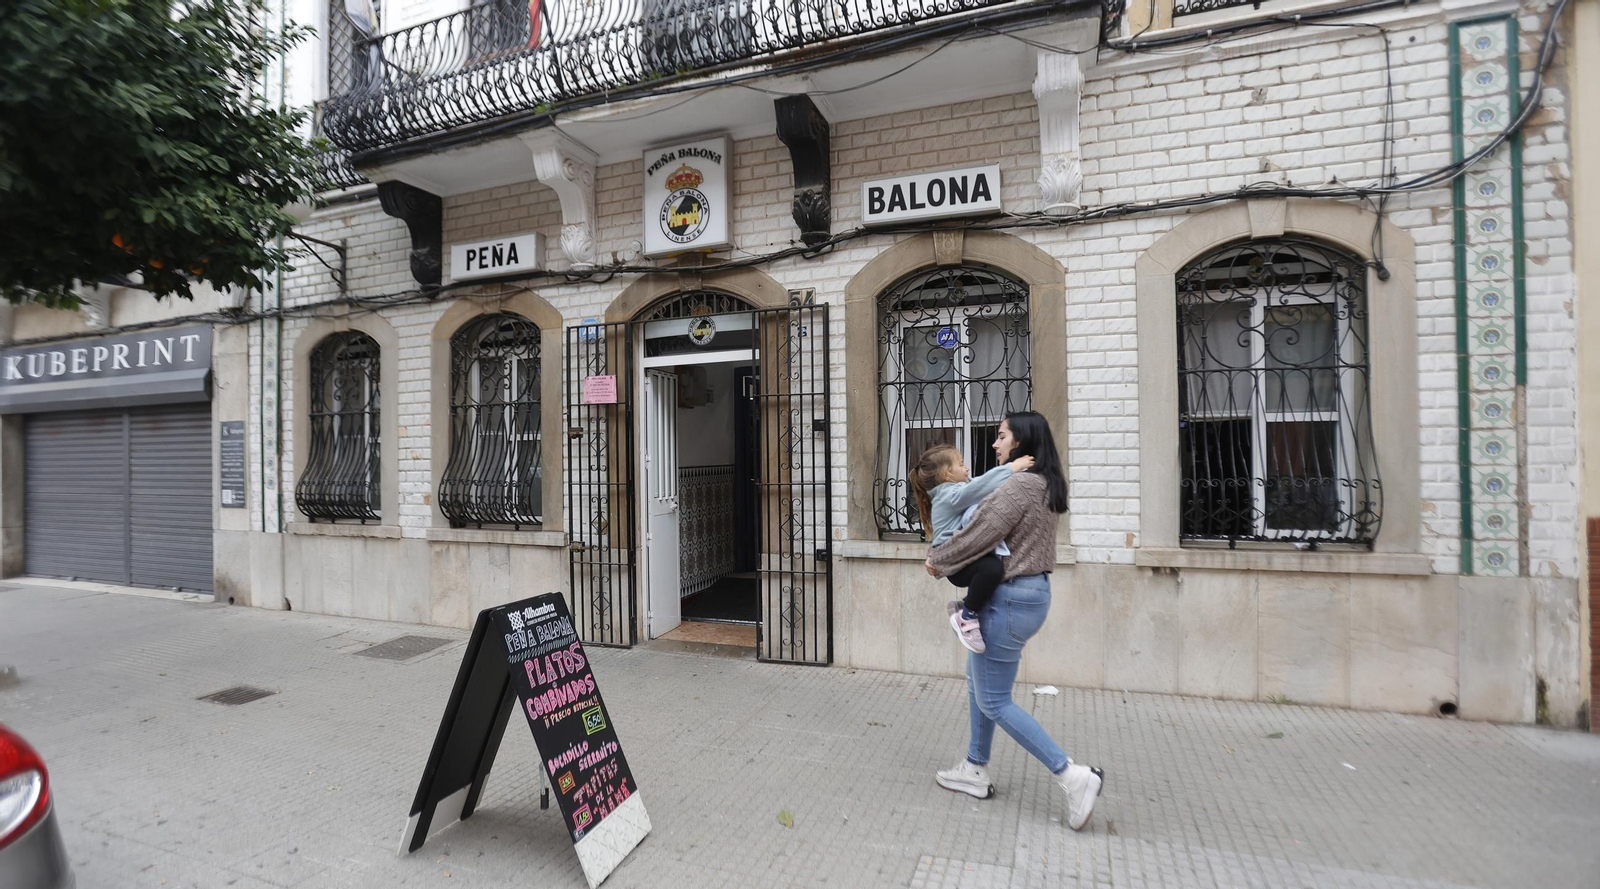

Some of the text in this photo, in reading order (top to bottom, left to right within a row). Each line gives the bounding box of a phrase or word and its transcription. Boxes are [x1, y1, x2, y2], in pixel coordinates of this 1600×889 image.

[647, 147, 722, 177] PEÑA BALONA
[679, 189, 708, 215] BALONA
[868, 173, 992, 215] BALONA
[667, 228, 702, 242] LINENSE
[466, 242, 519, 271] PEÑA
[789, 290, 814, 310] 54
[3, 334, 200, 380] KUBEPRINT
[522, 602, 556, 622] Alhambra
[535, 615, 575, 644] BALONA
[524, 640, 586, 689] PLATOS
[526, 673, 596, 721] COMBINADOS
[548, 741, 589, 777] BOCADILLO
[578, 741, 618, 772] SERRANITO
[573, 757, 618, 805] TAPITAS
[595, 784, 614, 806] DE LA
